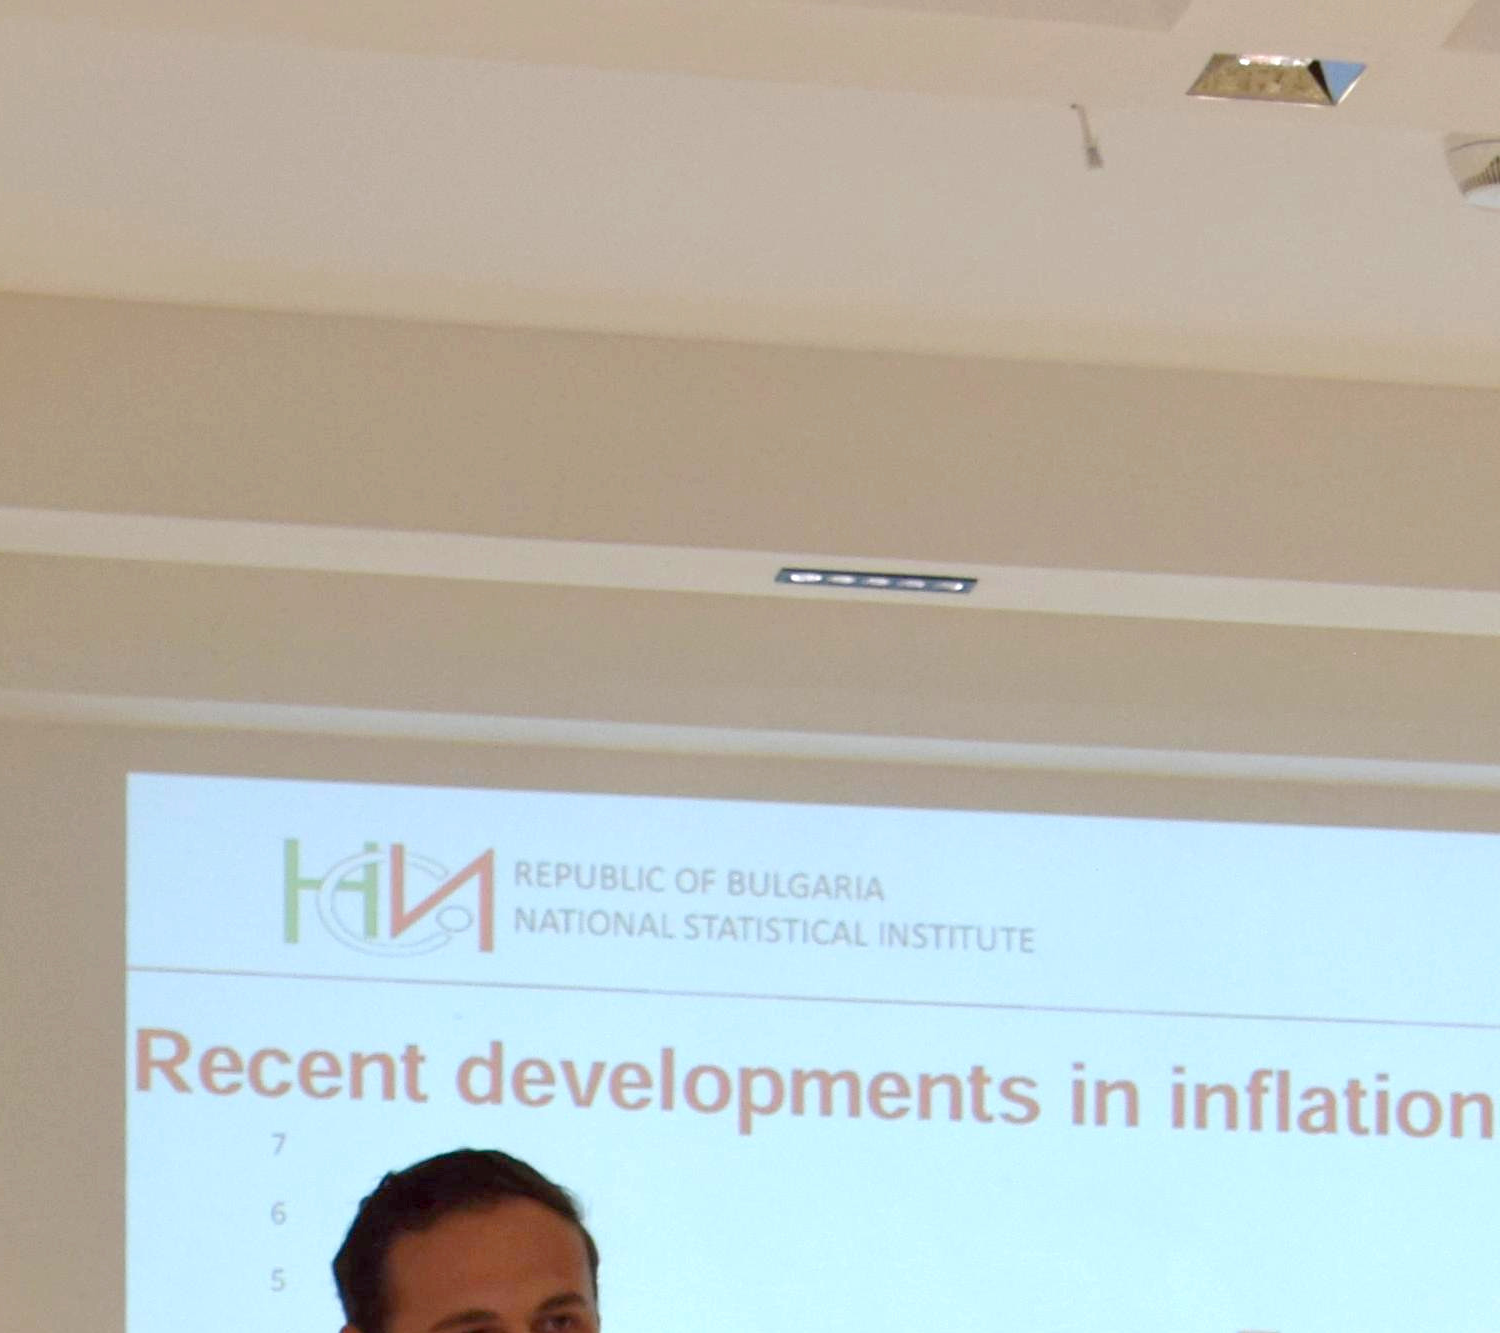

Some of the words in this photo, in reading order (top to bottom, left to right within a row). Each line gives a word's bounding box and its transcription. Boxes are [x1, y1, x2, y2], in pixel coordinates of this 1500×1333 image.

[513, 859, 666, 894] REPUBLIC
[673, 864, 717, 895] OF
[726, 867, 885, 902] BULGARIA
[513, 905, 676, 941] NATIONAL
[683, 911, 869, 947] STATISTICAL
[877, 920, 1036, 954] INSTITUTE
[136, 1028, 428, 1103] Recent
[457, 1042, 1040, 1136] developments
[1072, 1062, 1139, 1127] in
[1172, 1068, 1494, 1139] inflation
[269, 1131, 287, 1156] 7
[269, 1201, 287, 1226] 6
[270, 1267, 287, 1293] 5
